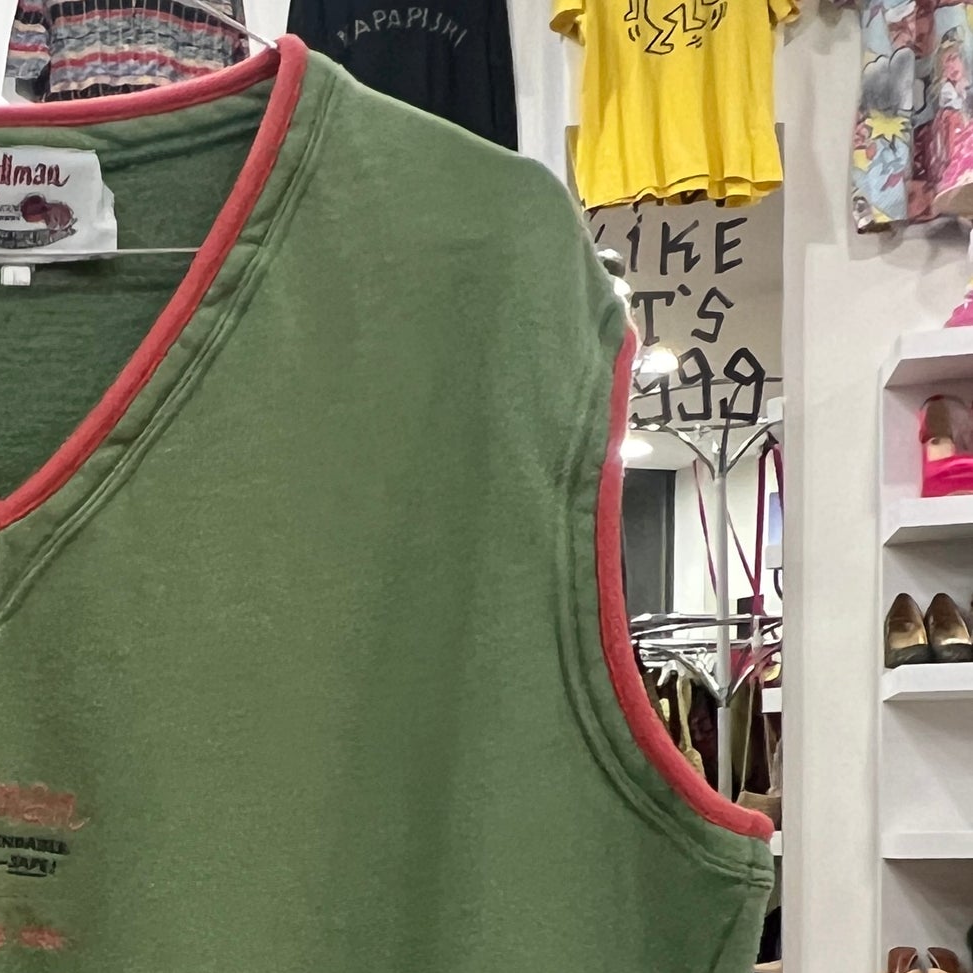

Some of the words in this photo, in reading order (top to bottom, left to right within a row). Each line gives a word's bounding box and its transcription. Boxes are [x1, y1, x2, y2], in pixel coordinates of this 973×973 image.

[594, 214, 748, 276] IKE
[632, 283, 735, 347] T'S
[631, 347, 766, 425] 999
